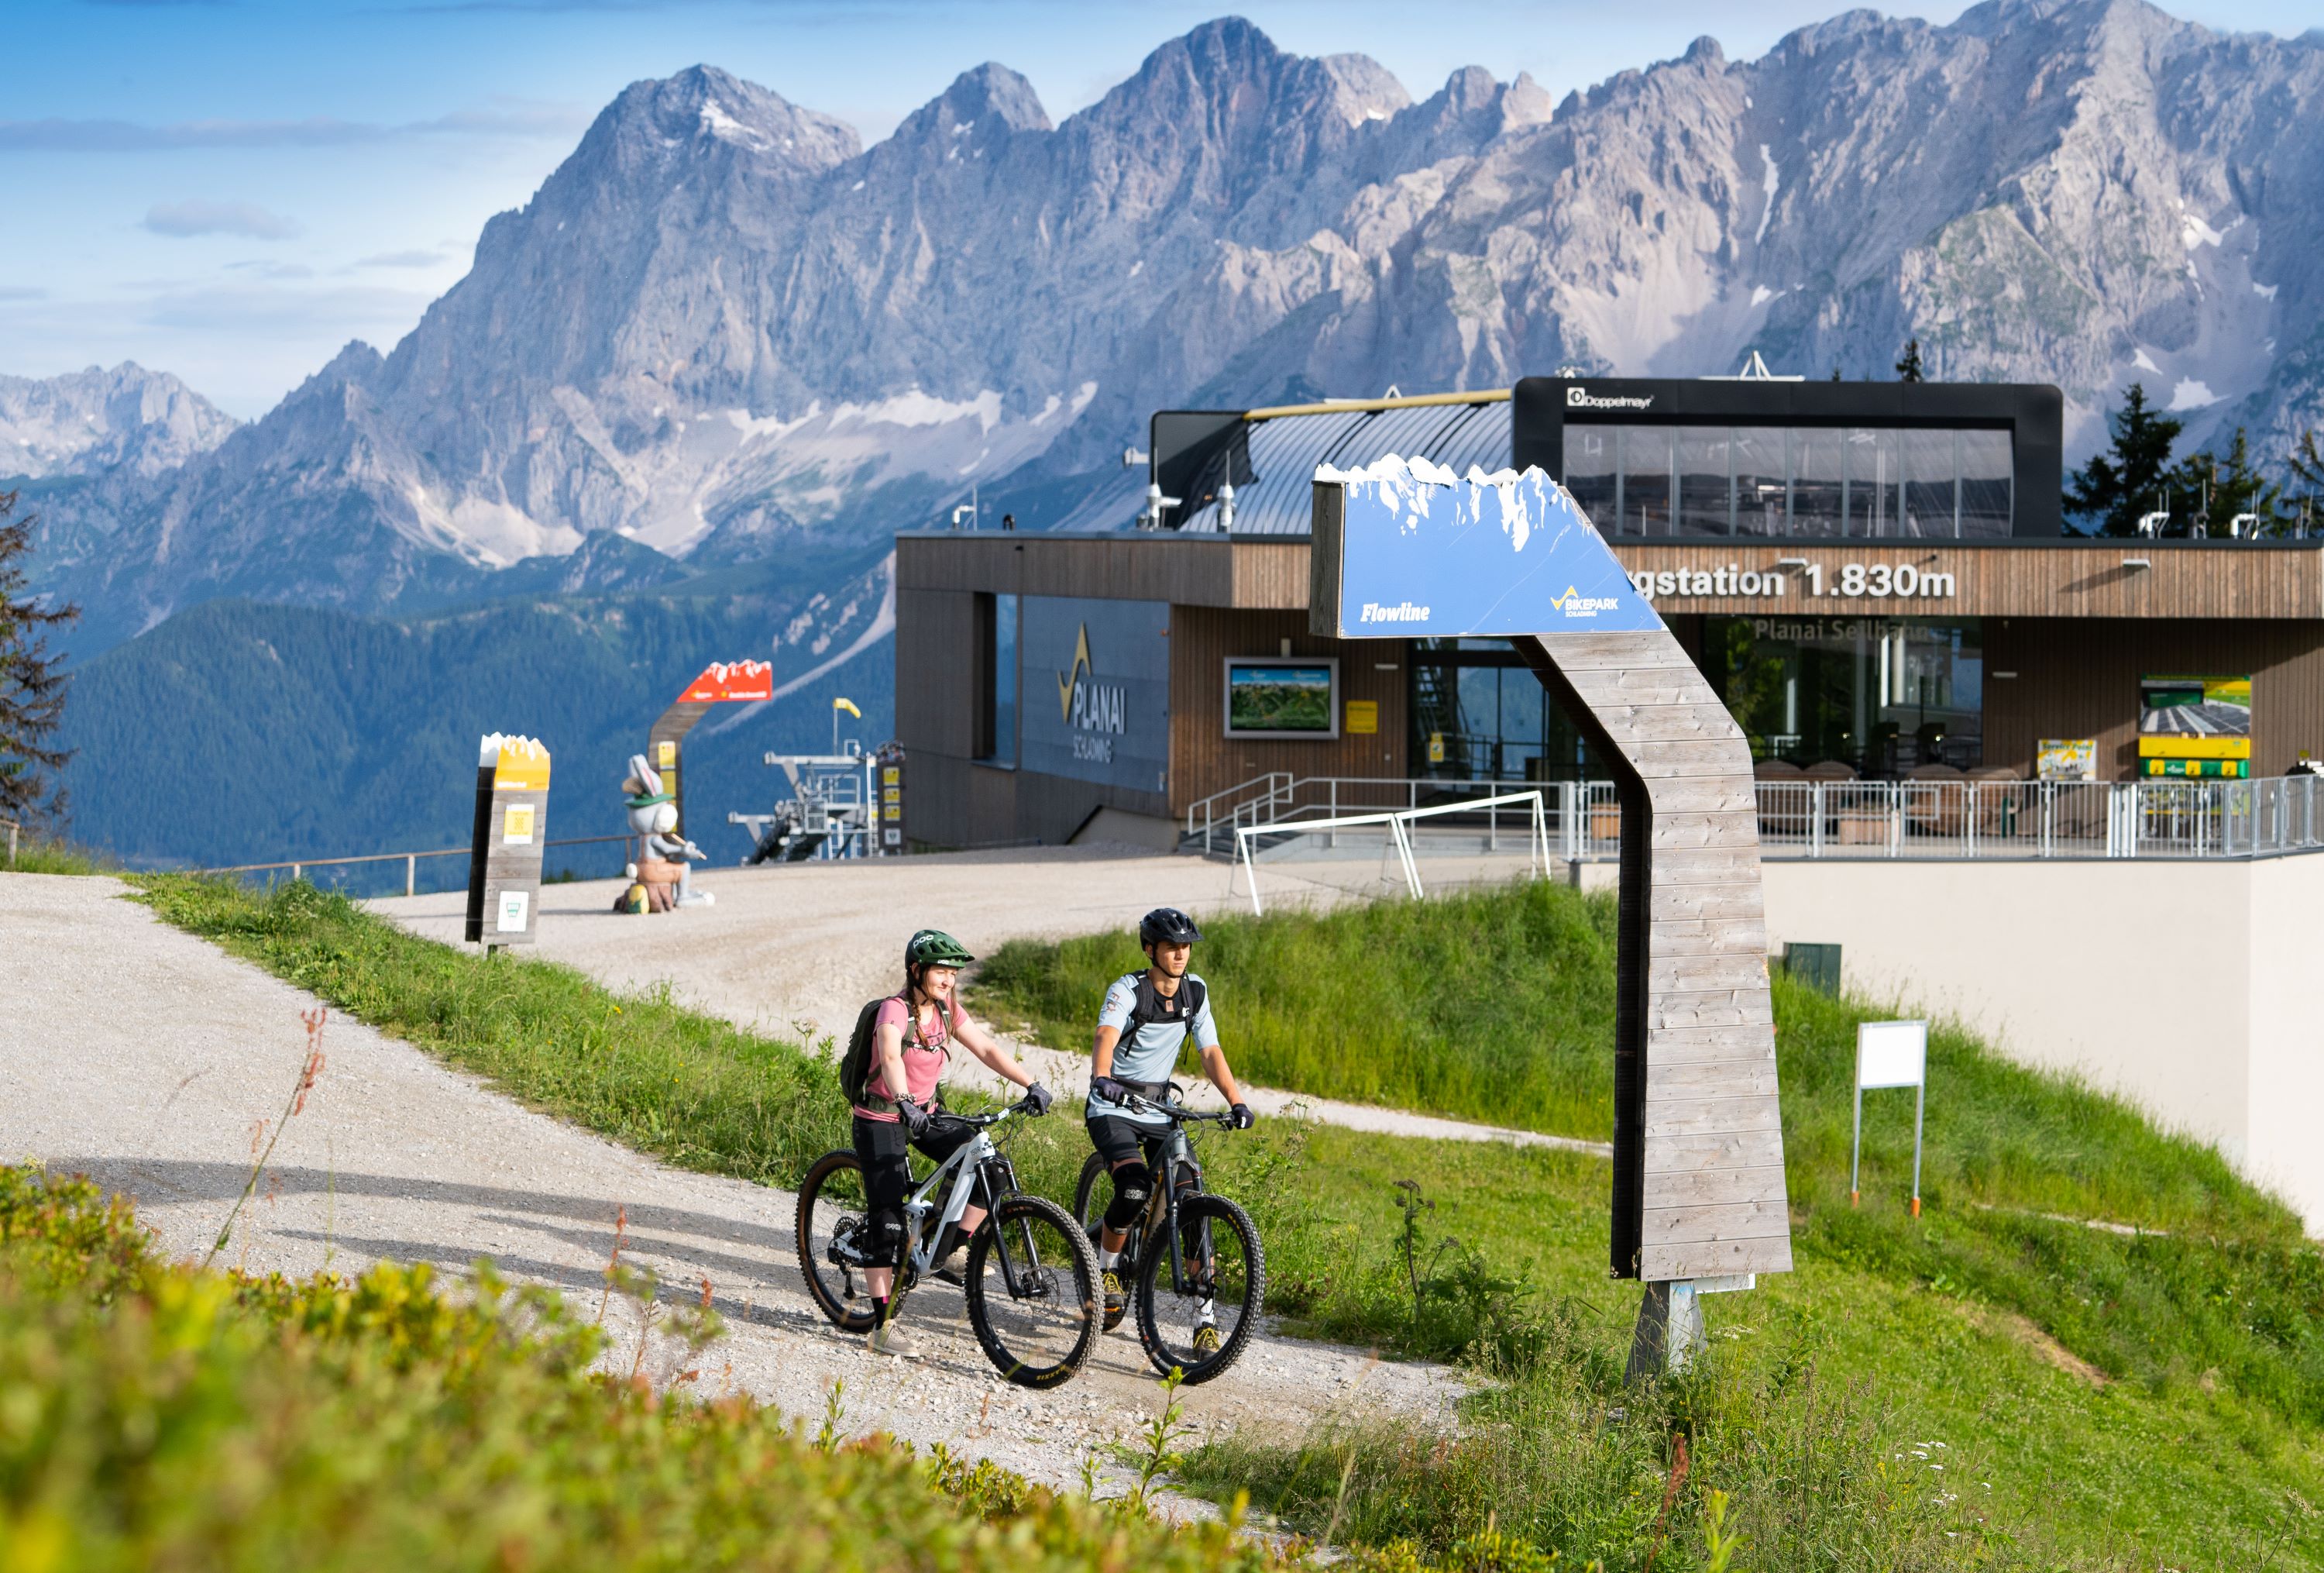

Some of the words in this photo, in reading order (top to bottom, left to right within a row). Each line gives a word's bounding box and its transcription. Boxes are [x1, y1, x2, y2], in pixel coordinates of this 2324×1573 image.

[1585, 395, 1652, 409] Doppelmayr
[1629, 563, 1785, 602] gstation
[1805, 563, 1955, 597] 1.830m
[1360, 602, 1431, 621] Flowline
[1566, 597, 1618, 611] BIKEPARK
[1755, 619, 1823, 640] Planai
[1831, 619, 1929, 641] Seilbahn
[1074, 682, 1126, 735] PLANAI
